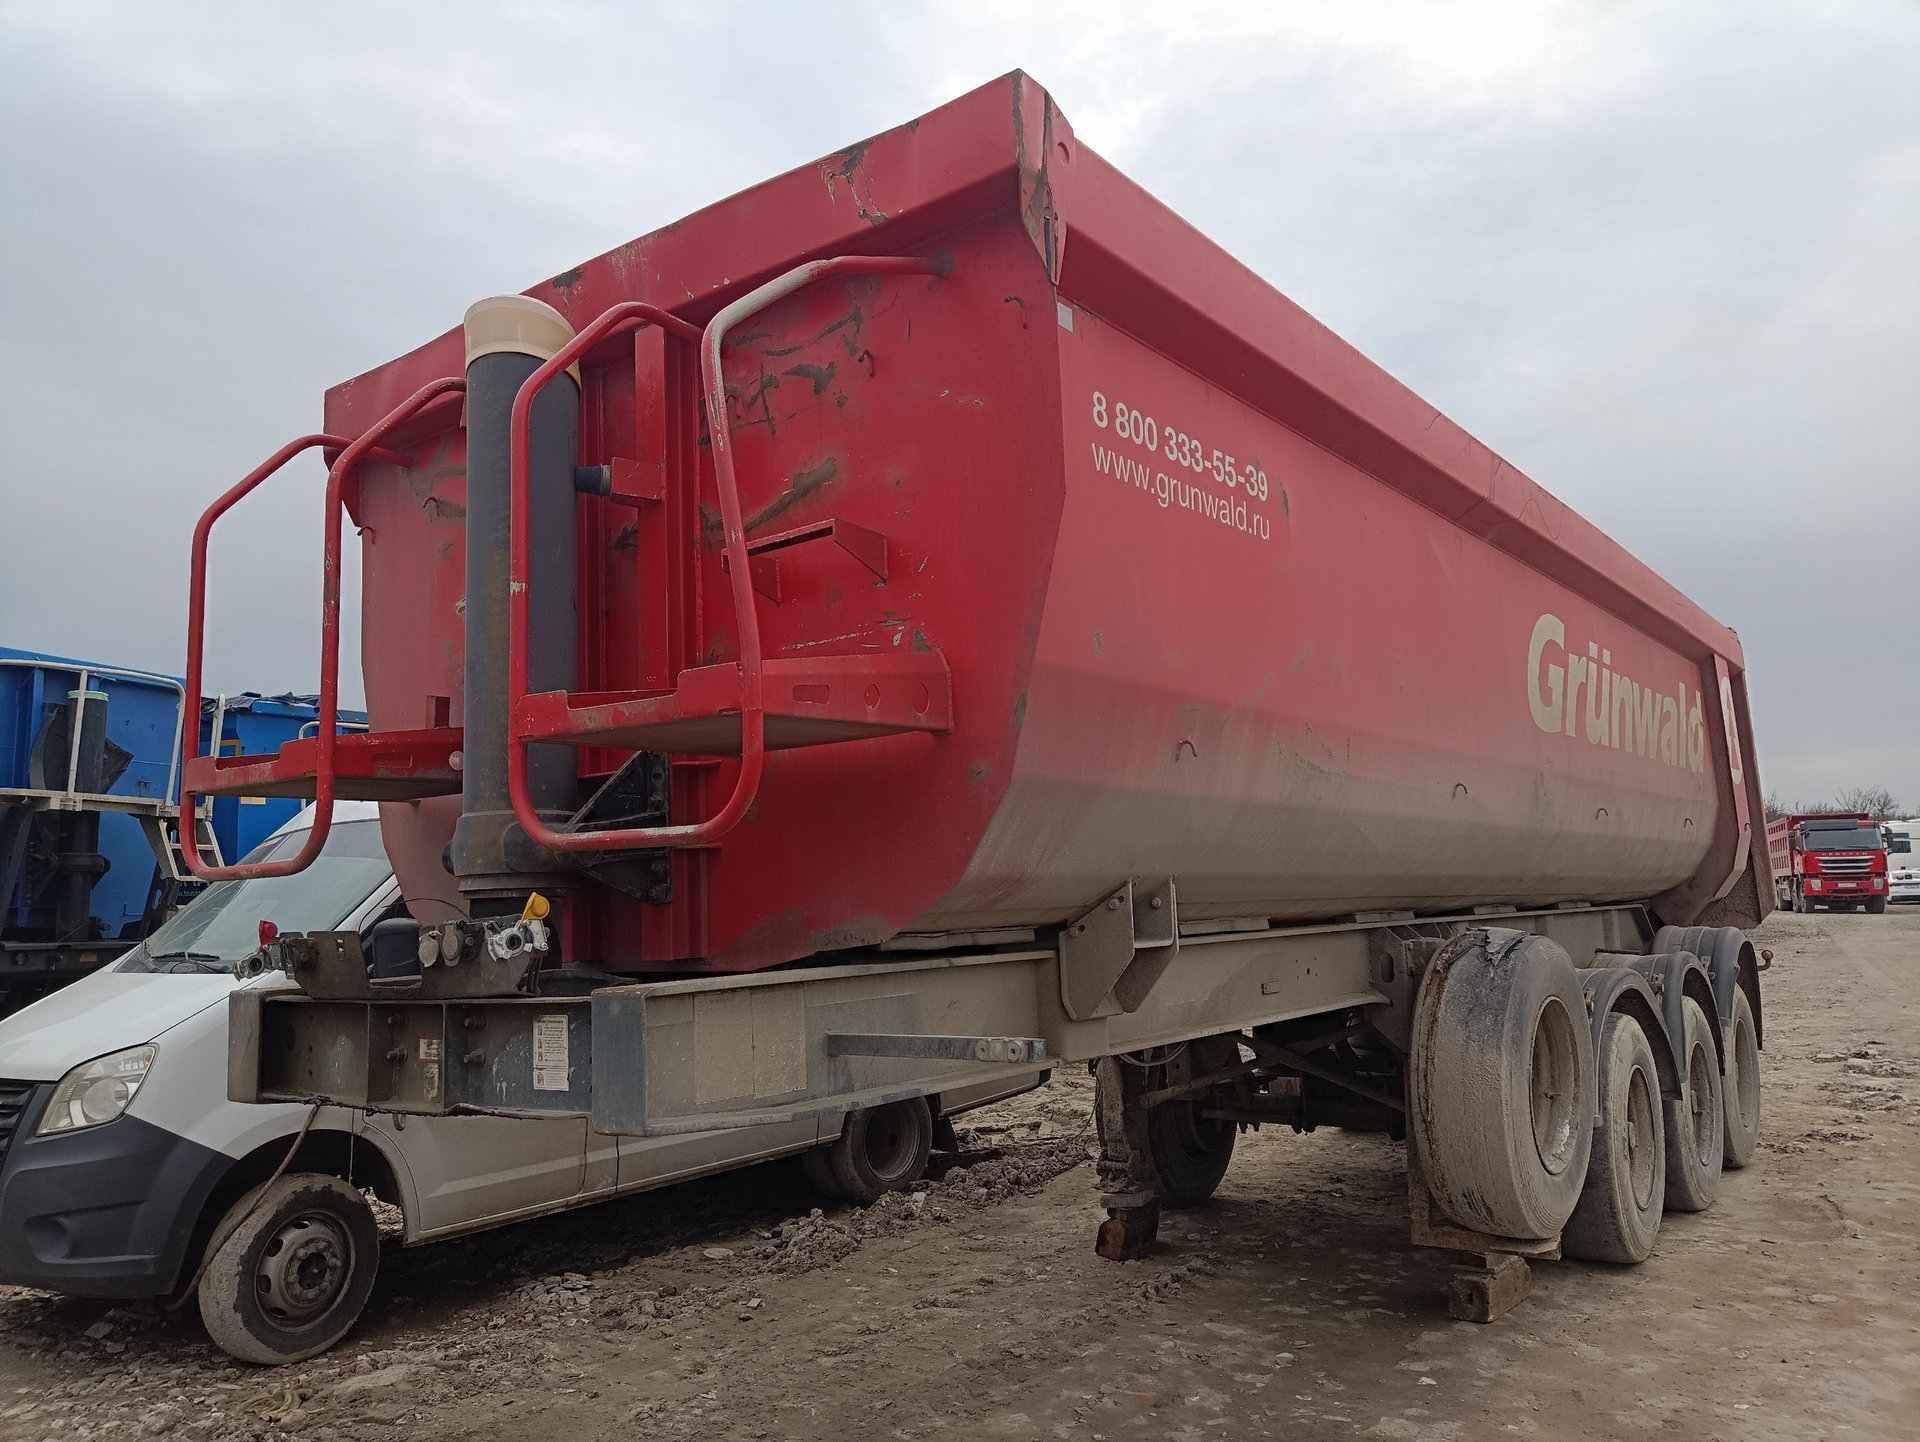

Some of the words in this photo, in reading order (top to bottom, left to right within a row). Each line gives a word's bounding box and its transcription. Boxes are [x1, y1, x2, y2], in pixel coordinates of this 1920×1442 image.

[1091, 442, 1270, 541] www.grunwald.ru
[1092, 391, 1108, 428] 8
[1115, 402, 1158, 451] 800
[1164, 426, 1268, 501] 333-55-39
[1527, 613, 1704, 773] Grünwald
